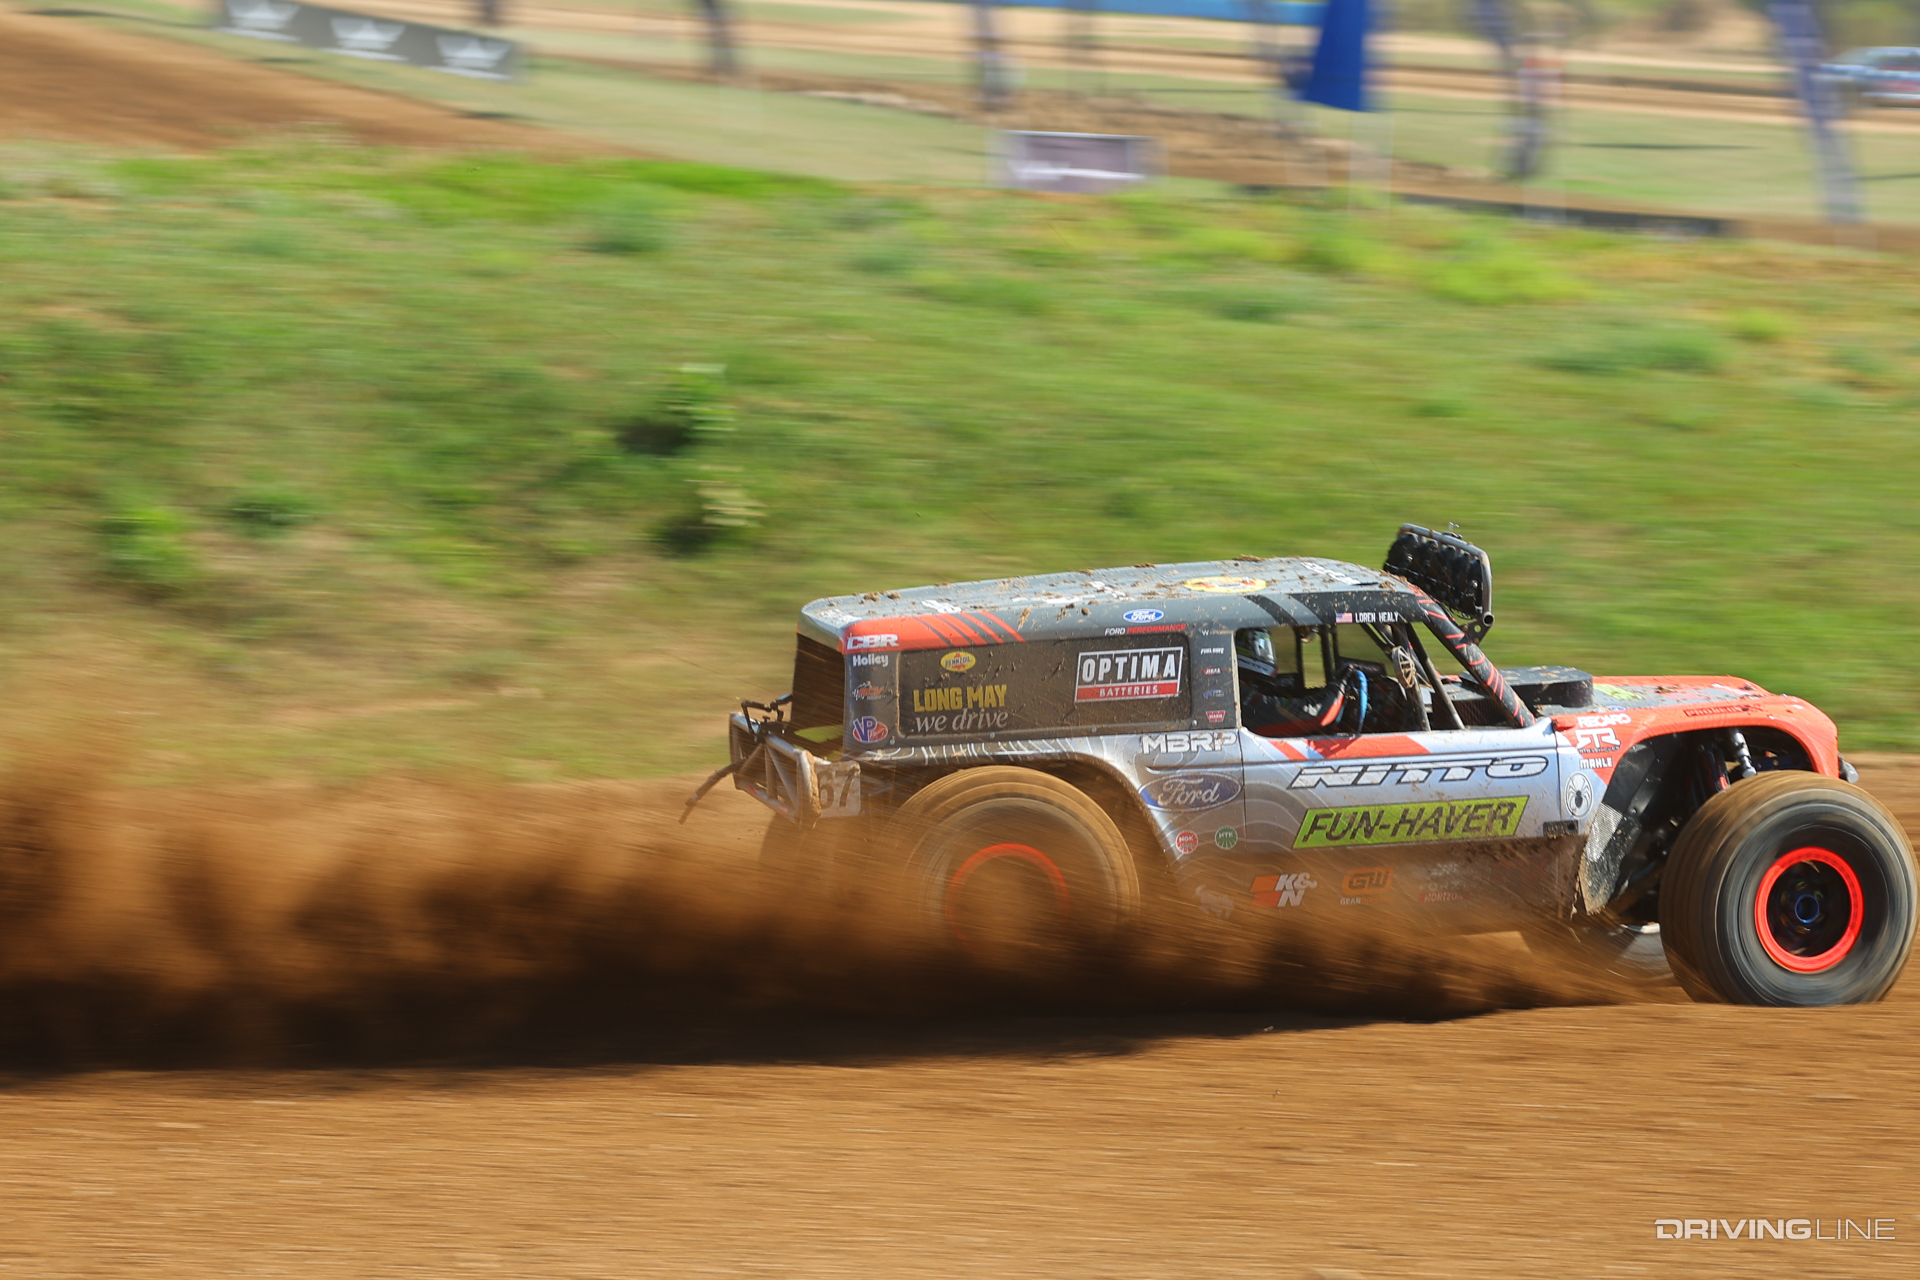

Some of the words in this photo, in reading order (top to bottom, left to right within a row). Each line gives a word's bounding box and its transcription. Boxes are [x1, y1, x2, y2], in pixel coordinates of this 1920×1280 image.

[1131, 610, 1157, 621] Ford
[1355, 612, 1376, 623] LOREN
[1378, 611, 1399, 622] HEALY
[1105, 627, 1126, 636] FORD
[1126, 623, 1187, 634] PERFORMANCE
[846, 633, 900, 650] CBR
[852, 653, 889, 668] Holley
[945, 656, 971, 667] PENNZOIL
[1082, 653, 1176, 682] OPTIMA
[913, 687, 963, 712] LONG
[966, 684, 1007, 709] MAY
[1099, 684, 1158, 697] BATTERIES
[853, 716, 878, 743] VP
[915, 714, 948, 733] we
[952, 707, 1009, 731] drive
[1577, 713, 1632, 728] RECARO
[1142, 732, 1237, 754] MBRP
[1575, 727, 1621, 750] RTR
[1287, 755, 1549, 790] NITTO
[1580, 757, 1613, 769] MAHLE
[1157, 778, 1220, 806] Ford
[1301, 801, 1518, 843] FUN-HAVER
[1274, 872, 1318, 892] K&
[1277, 890, 1306, 908] N
